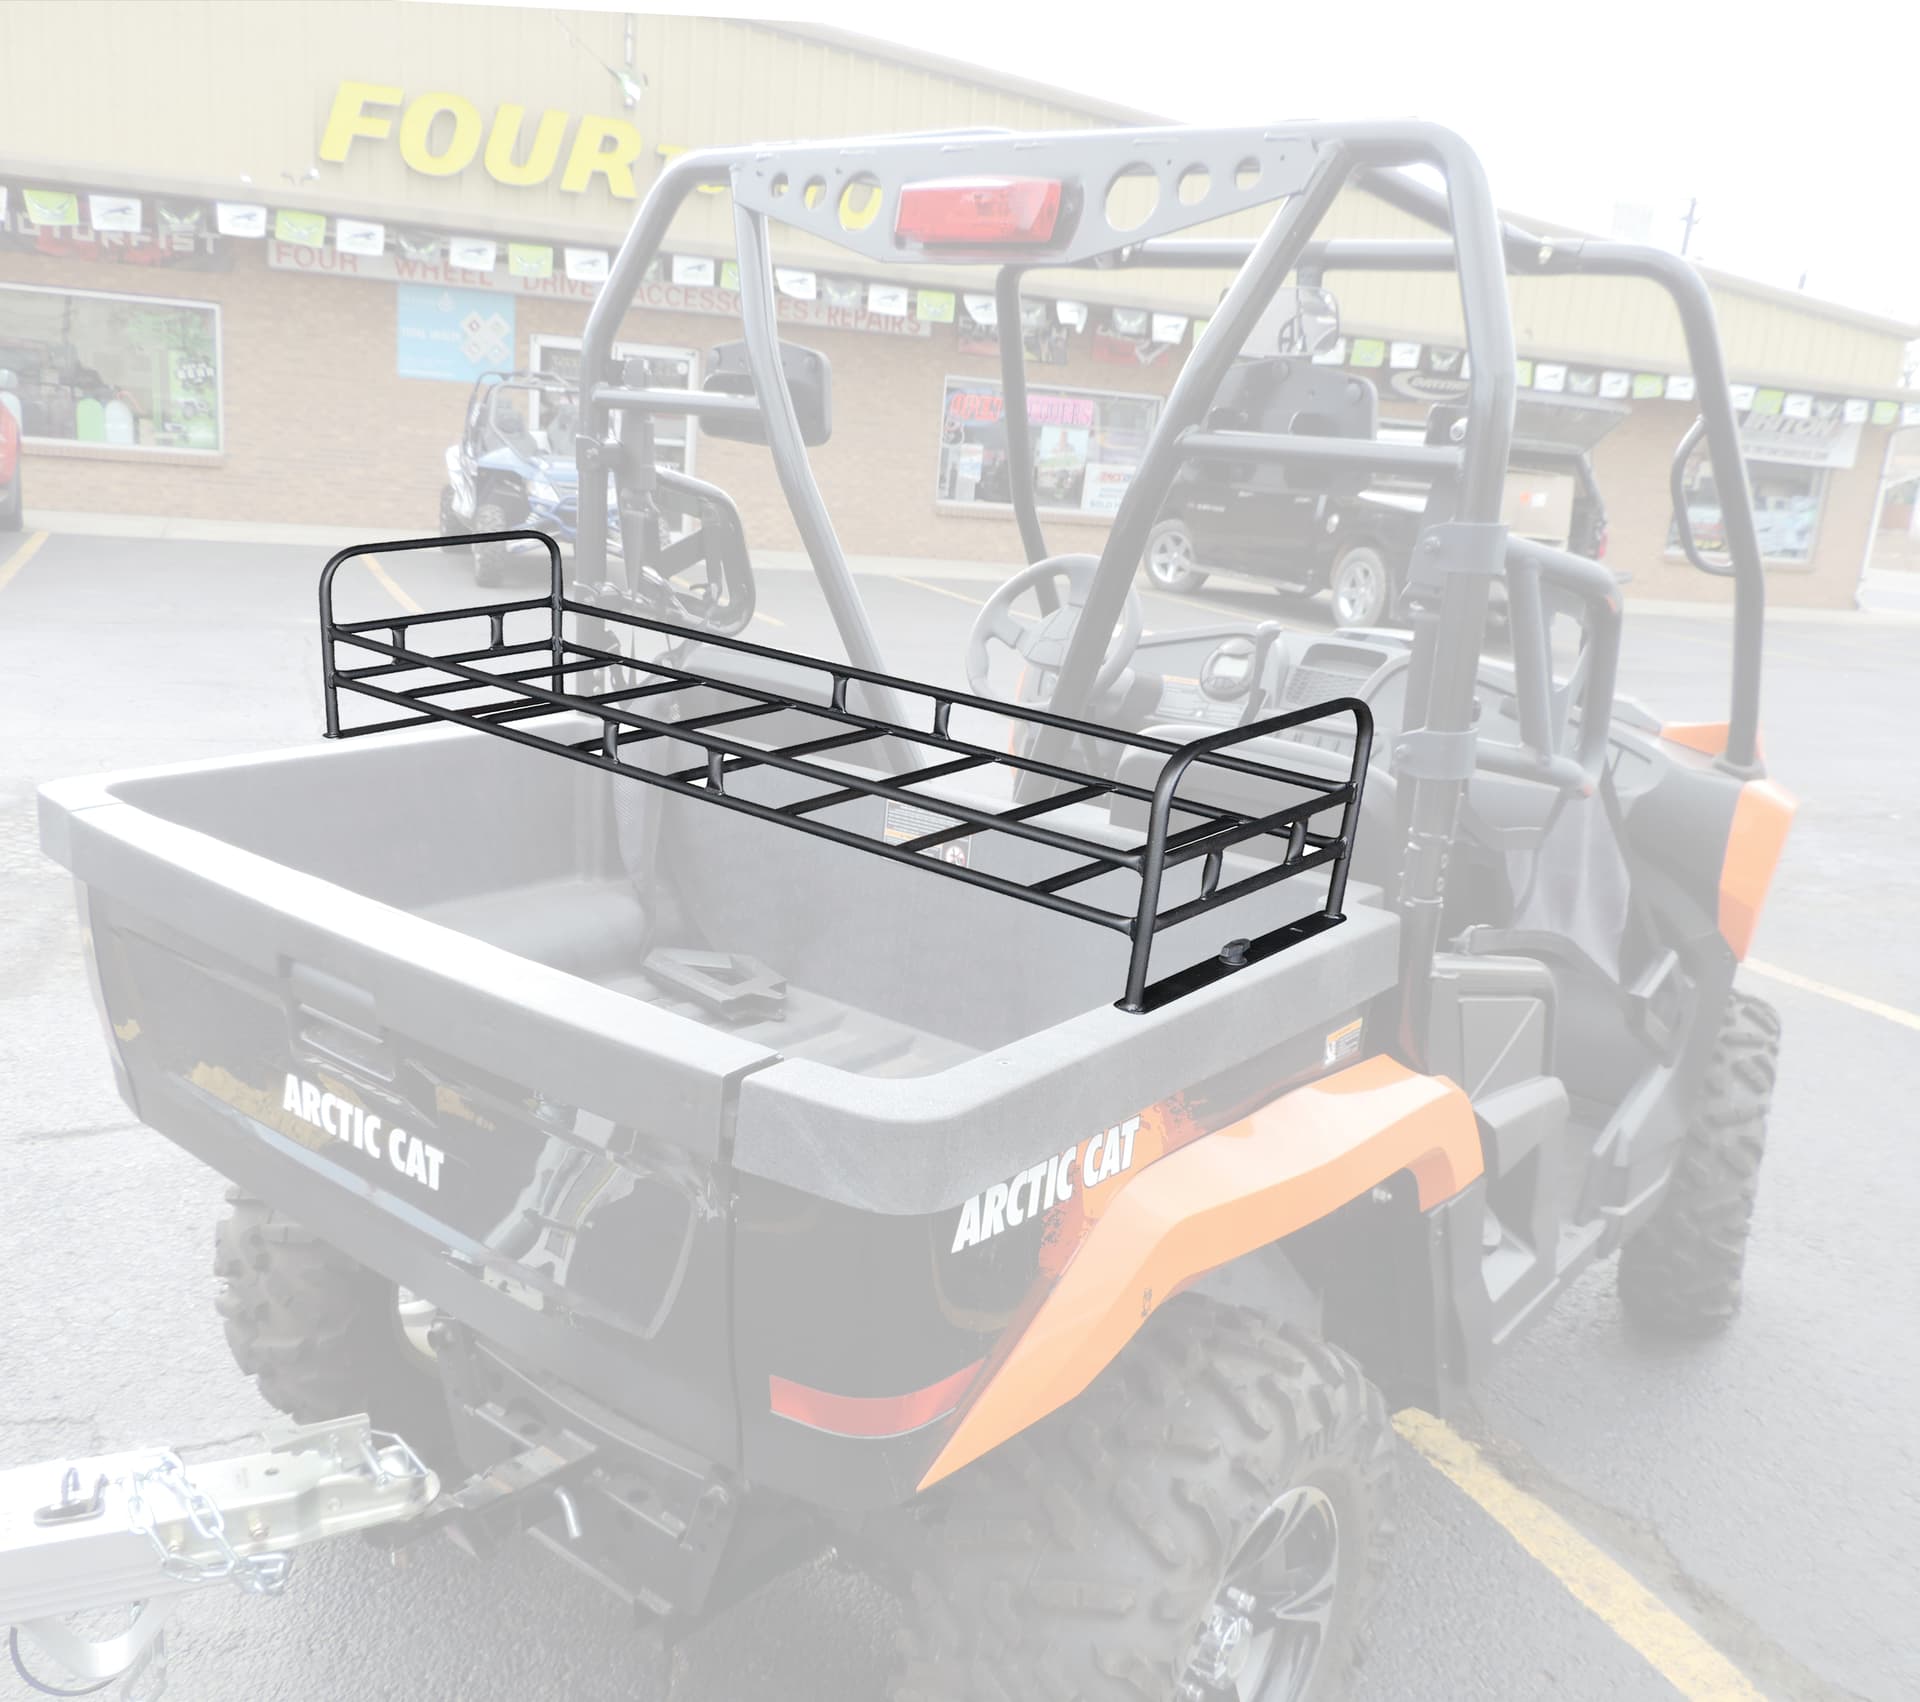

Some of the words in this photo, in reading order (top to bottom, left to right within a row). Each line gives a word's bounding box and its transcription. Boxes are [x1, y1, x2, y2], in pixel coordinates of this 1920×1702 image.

[318, 80, 642, 200] FOUR
[275, 242, 359, 272] FOUR
[394, 254, 494, 287] WHEEL
[633, 281, 809, 321] ACCESSOES
[826, 305, 921, 335] REPAIRS
[950, 393, 1003, 422] OPEN
[283, 1073, 381, 1159] ARCTIC
[388, 1128, 445, 1191] CAT
[951, 1144, 1077, 1255] ARCTIC
[1081, 1114, 1141, 1188] CAT
